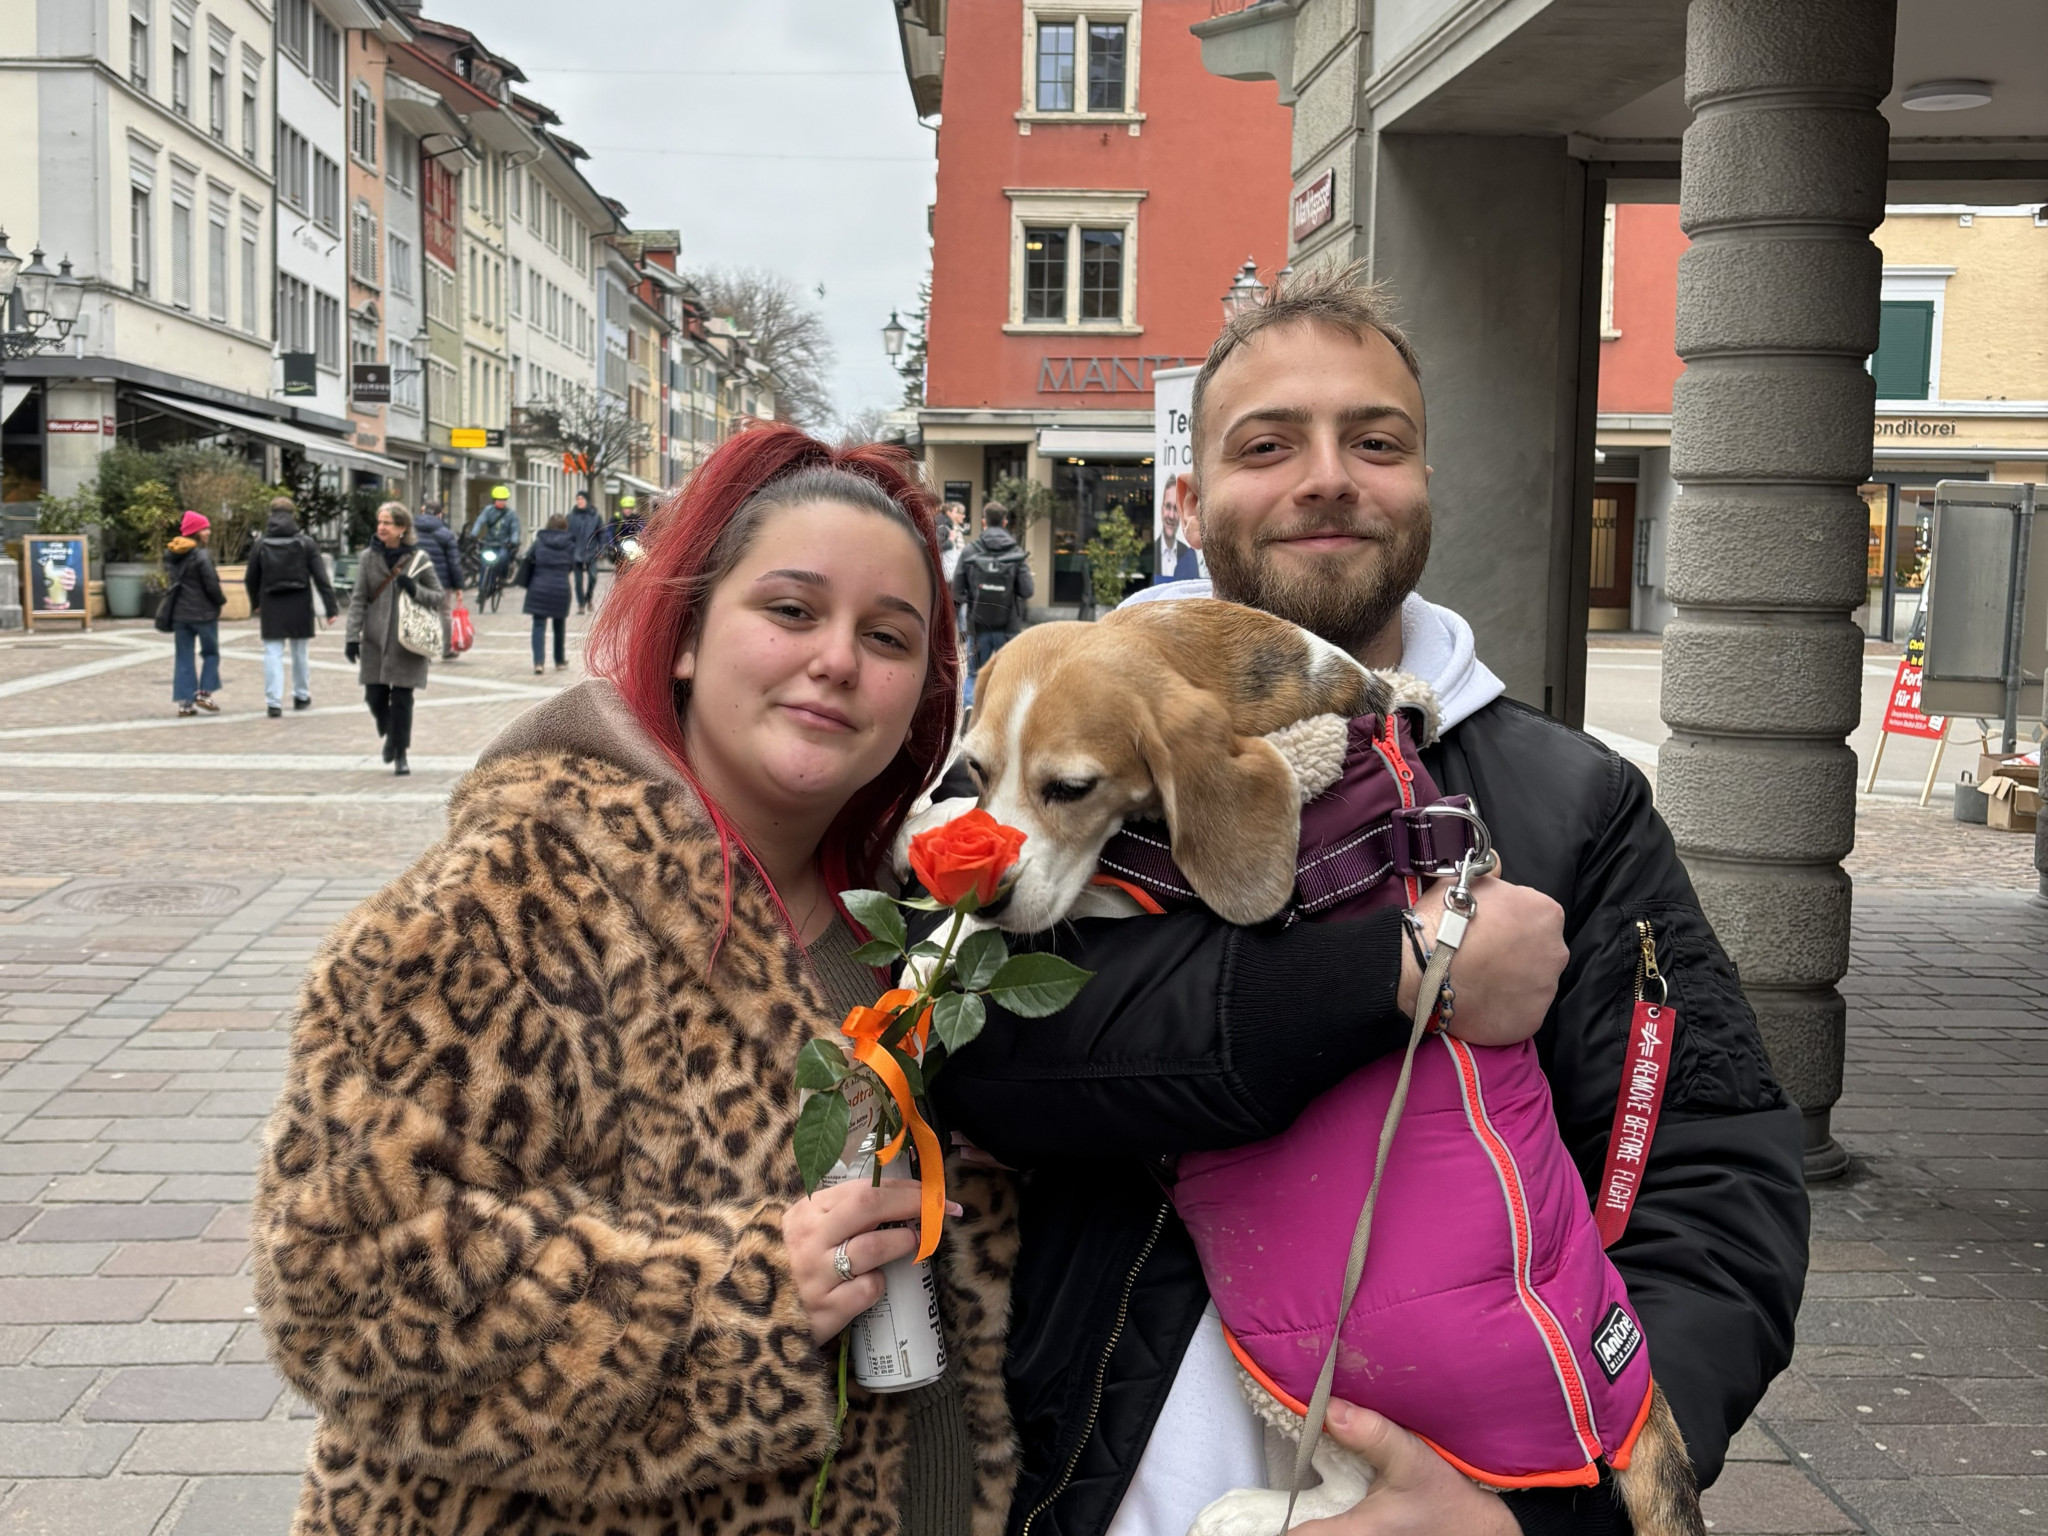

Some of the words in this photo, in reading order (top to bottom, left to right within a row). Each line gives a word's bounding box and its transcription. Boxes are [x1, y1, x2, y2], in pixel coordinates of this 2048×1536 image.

[1163, 439, 1177, 466] in
[1626, 1058, 1660, 1115] REMOVE
[1616, 1114, 1649, 1165] BEFORE
[1606, 1169, 1636, 1213] FLIGHT
[921, 1273, 939, 1320] Bull
[930, 1322, 946, 1368] Red
[1601, 1315, 1633, 1362] AniOne
